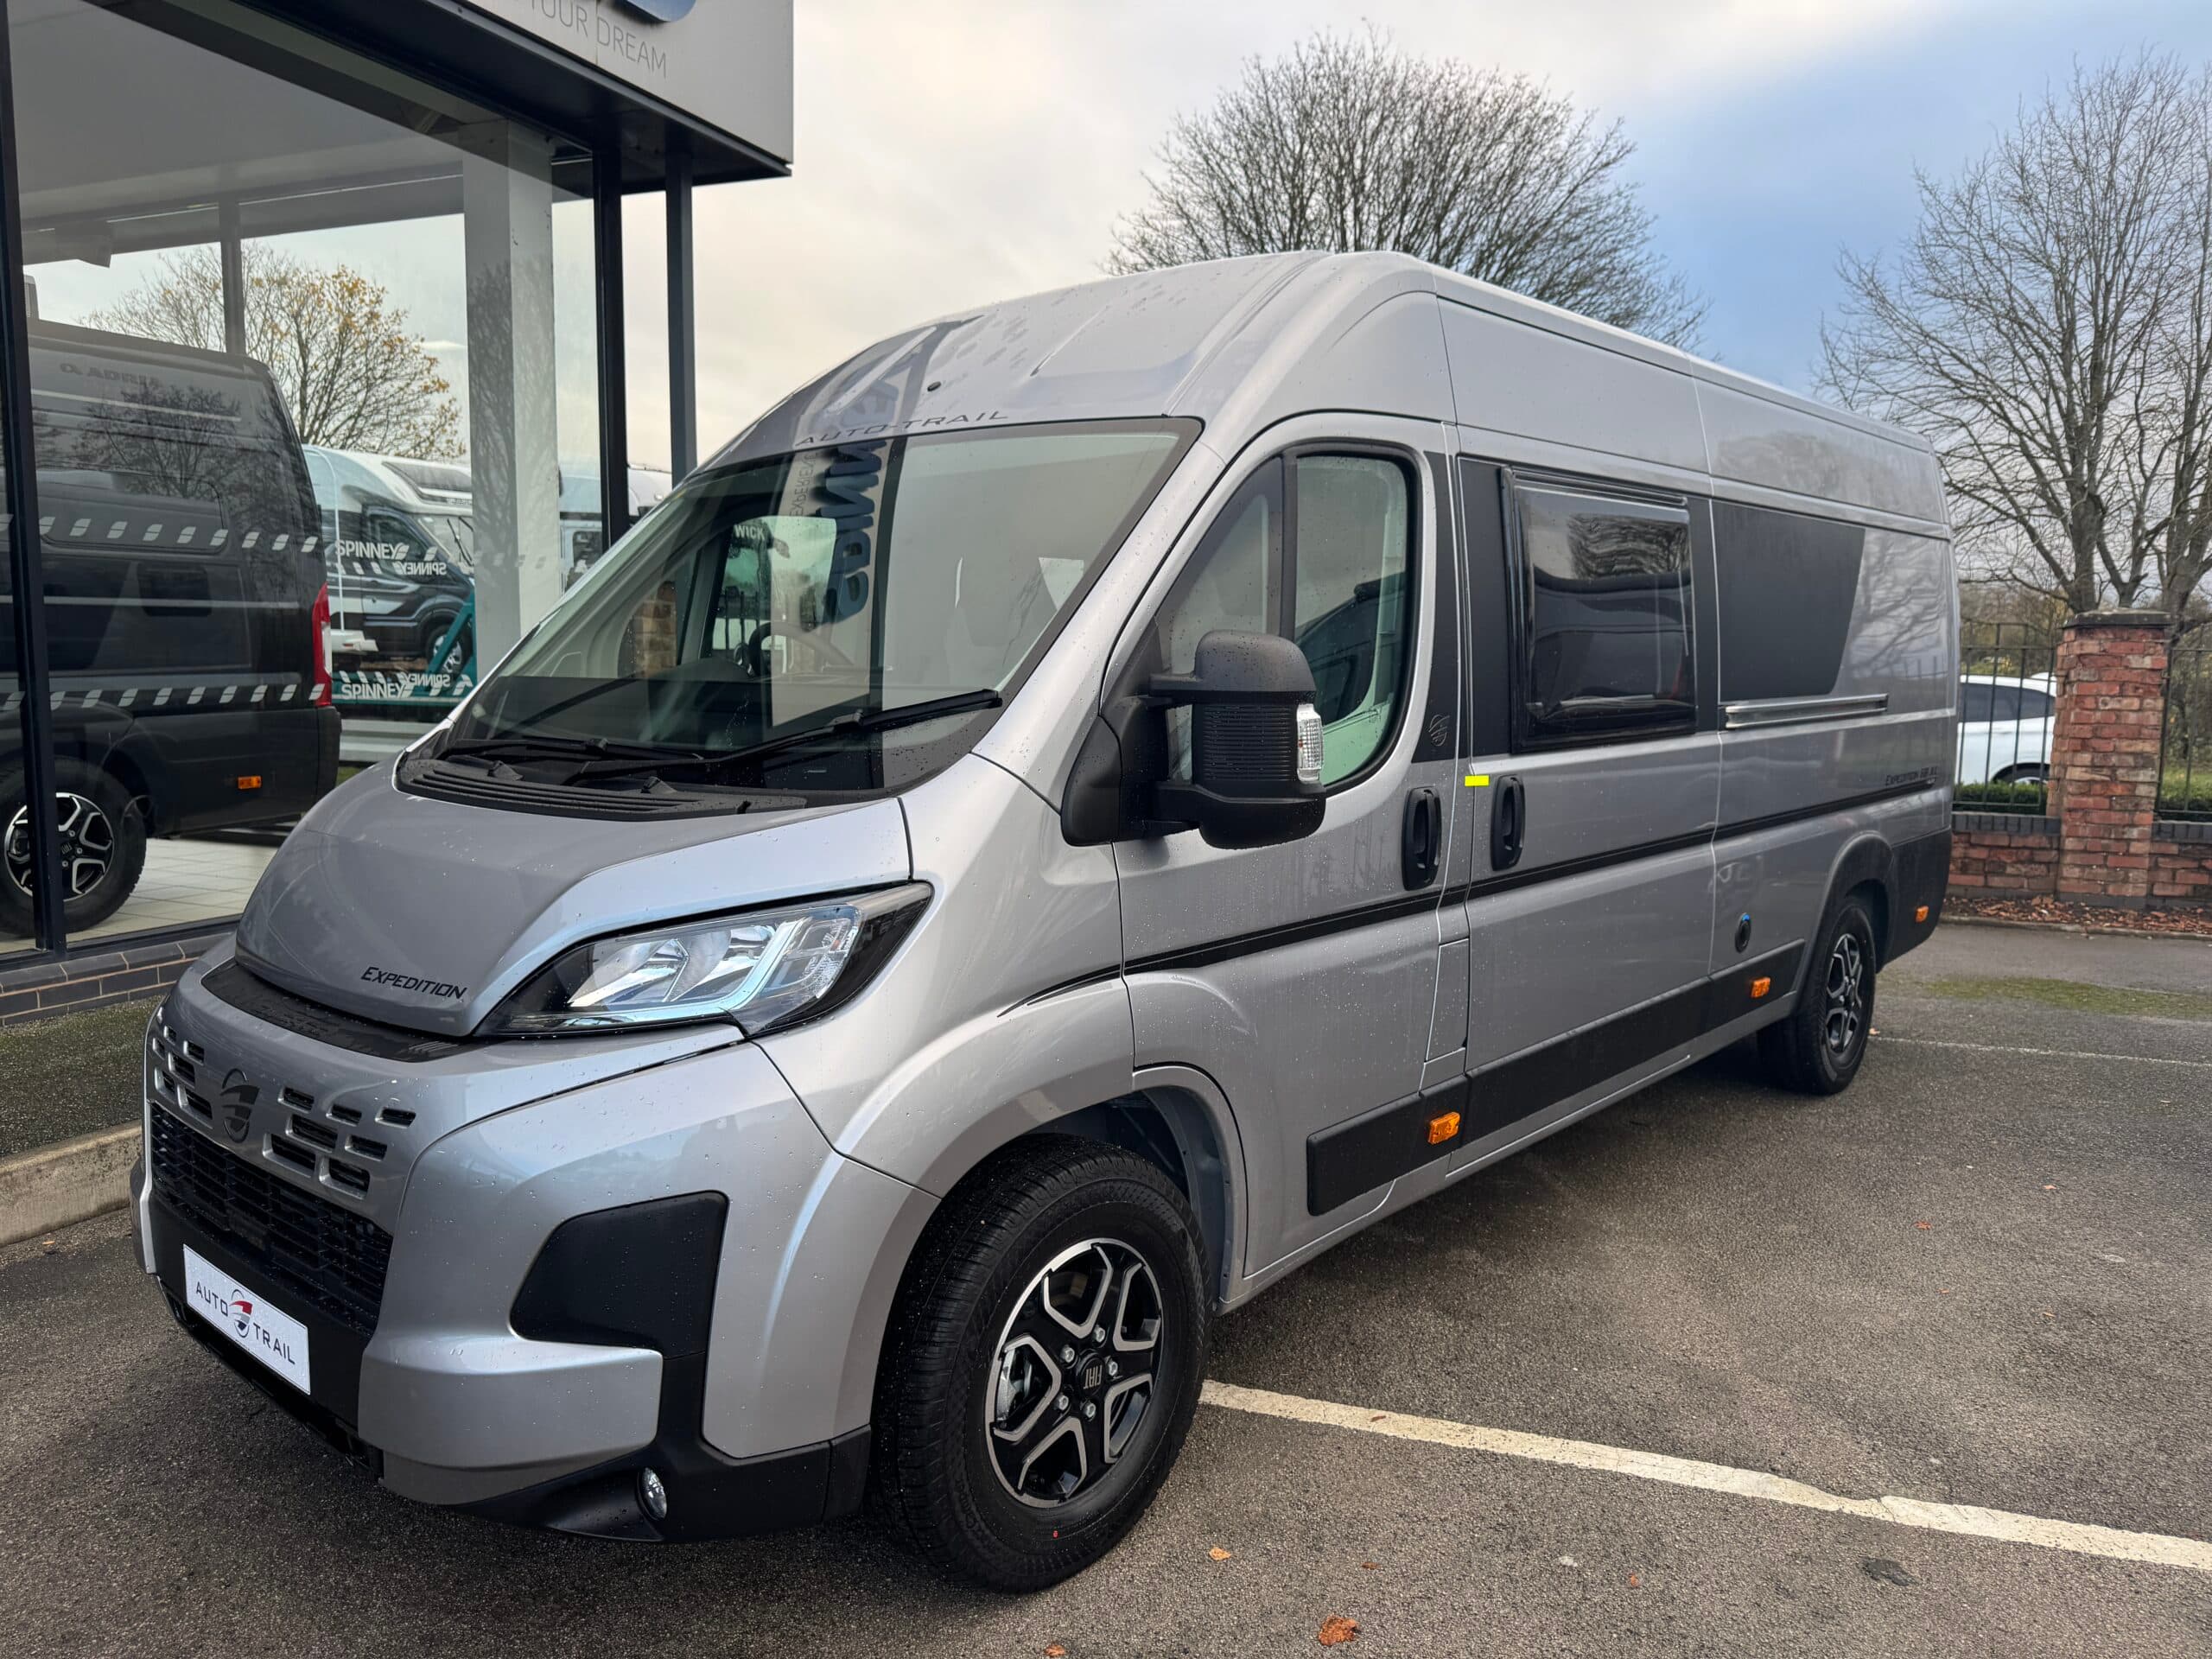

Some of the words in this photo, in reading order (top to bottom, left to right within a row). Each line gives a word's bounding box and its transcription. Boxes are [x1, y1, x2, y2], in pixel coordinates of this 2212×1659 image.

[597, 16, 667, 79] DREAM
[795, 410, 1008, 447] AUTO-TRAIL
[335, 539, 398, 560] SPINNEY
[341, 683, 404, 699] SPINNEY
[195, 1281, 228, 1317] AUTO
[253, 1322, 296, 1365] TRAIL
